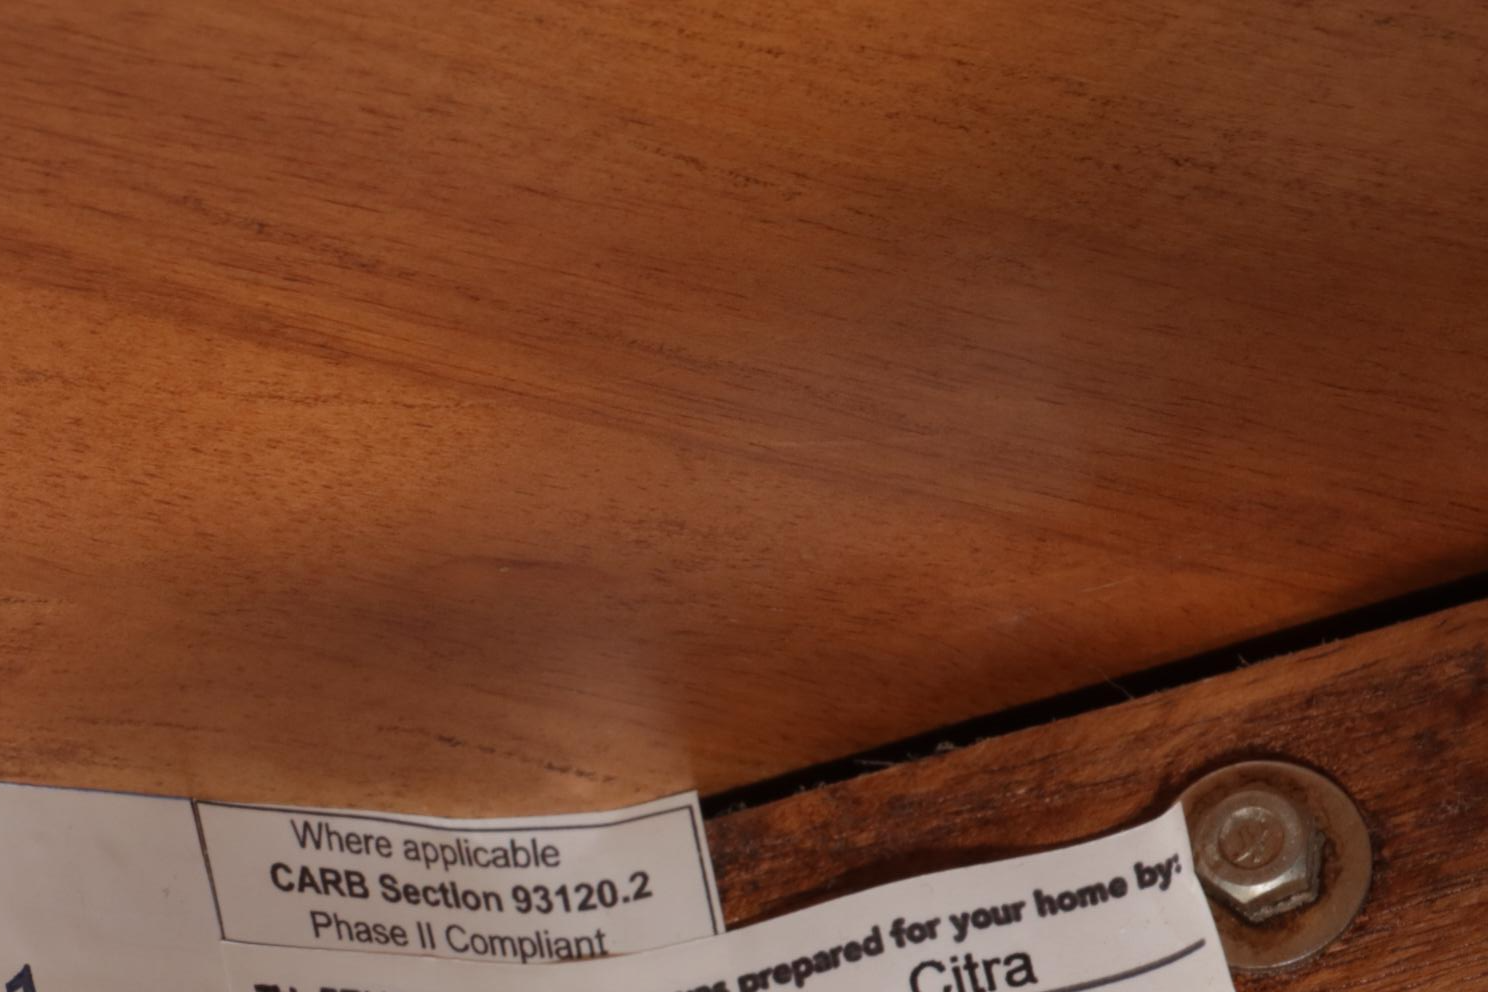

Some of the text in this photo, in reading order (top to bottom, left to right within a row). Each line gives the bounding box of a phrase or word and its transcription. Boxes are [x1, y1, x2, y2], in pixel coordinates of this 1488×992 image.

[291, 818, 561, 873] Where applicable
[269, 861, 654, 915] CARB Section 93120.2
[889, 917, 942, 949] for
[948, 899, 1027, 944] your
[1032, 875, 1129, 919] home
[1133, 852, 1184, 892] by:
[309, 909, 610, 965] Phase II Compliant
